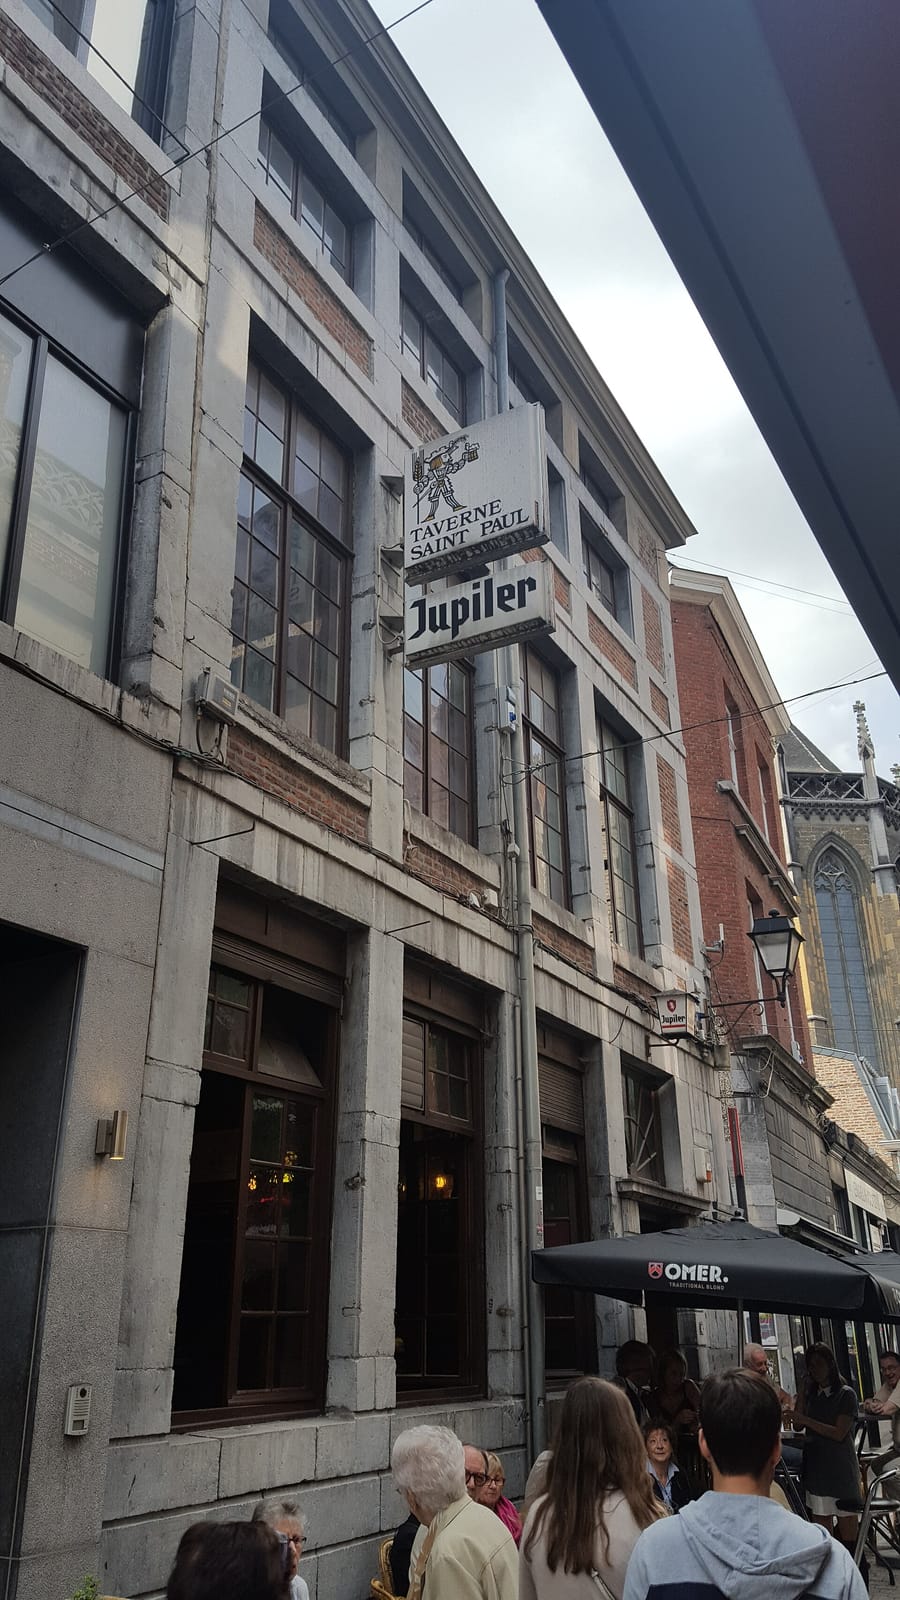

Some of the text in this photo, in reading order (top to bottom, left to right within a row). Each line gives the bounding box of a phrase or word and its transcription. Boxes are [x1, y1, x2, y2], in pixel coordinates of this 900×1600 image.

[410, 500, 502, 543] TAVERNE
[411, 508, 529, 560] SAINT PAUL
[408, 576, 537, 640] Jupiler
[661, 1015, 685, 1024] Jupiler
